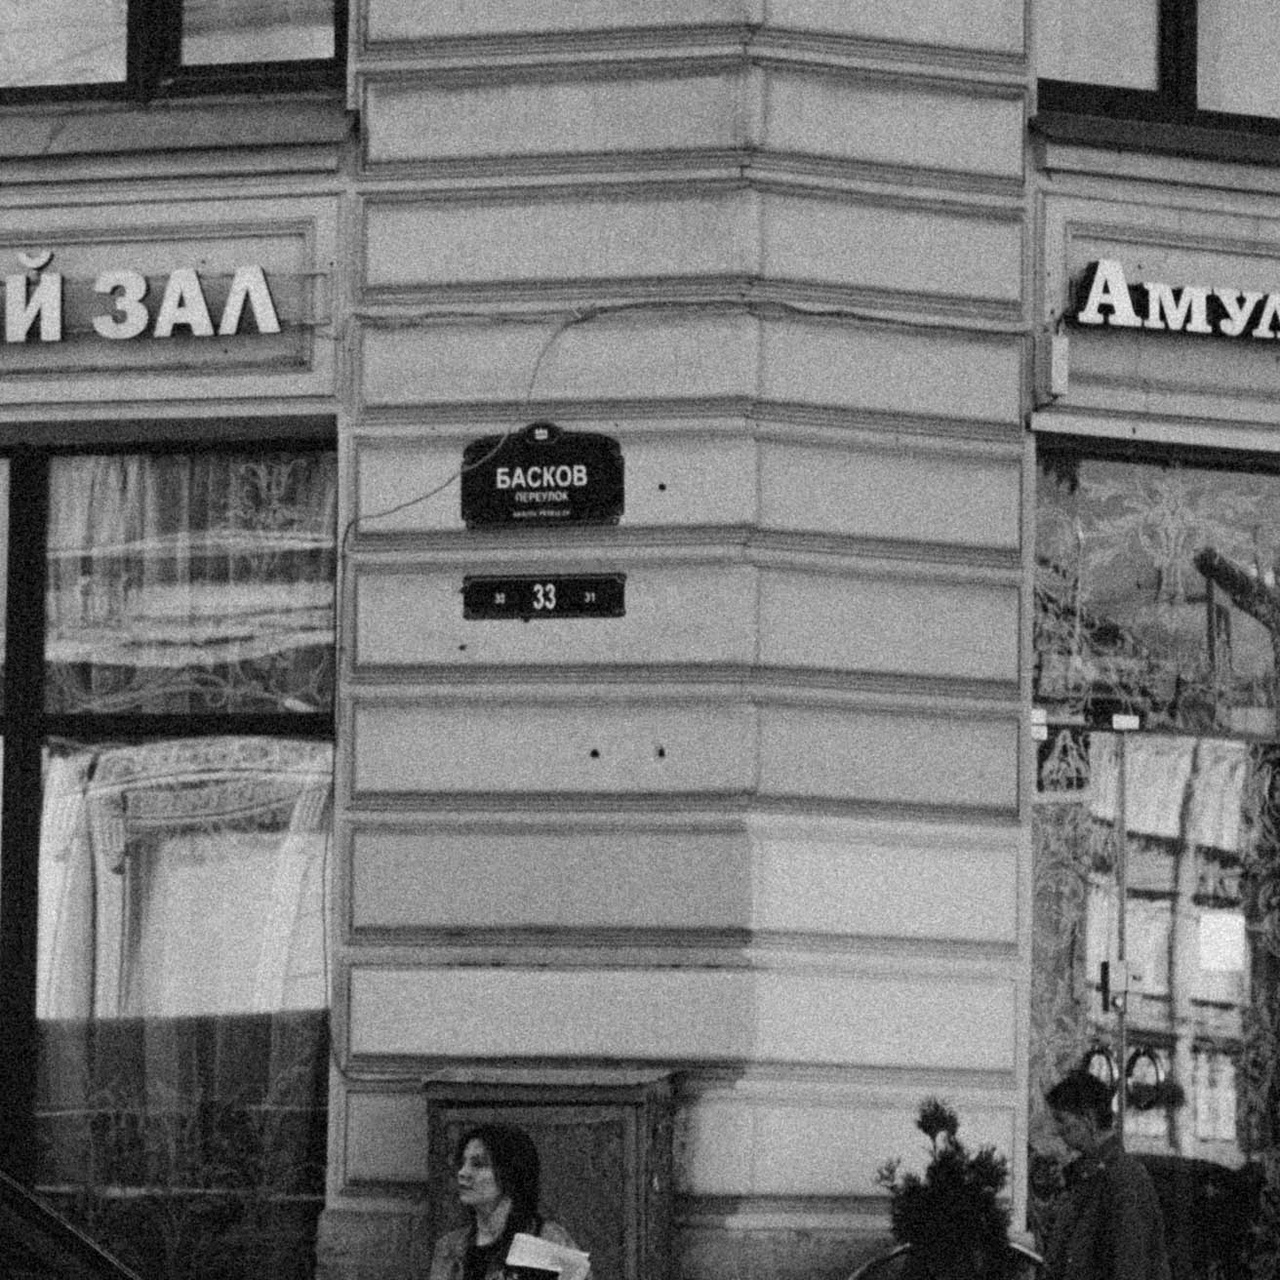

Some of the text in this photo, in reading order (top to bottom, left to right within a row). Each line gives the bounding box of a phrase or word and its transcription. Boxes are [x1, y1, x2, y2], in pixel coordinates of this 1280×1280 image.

[92, 264, 282, 340] ЗАЛ
[495, 464, 588, 490] БАСКОВ
[514, 490, 569, 503] ПЕРЕУЛОК
[532, 583, 556, 610] 33
